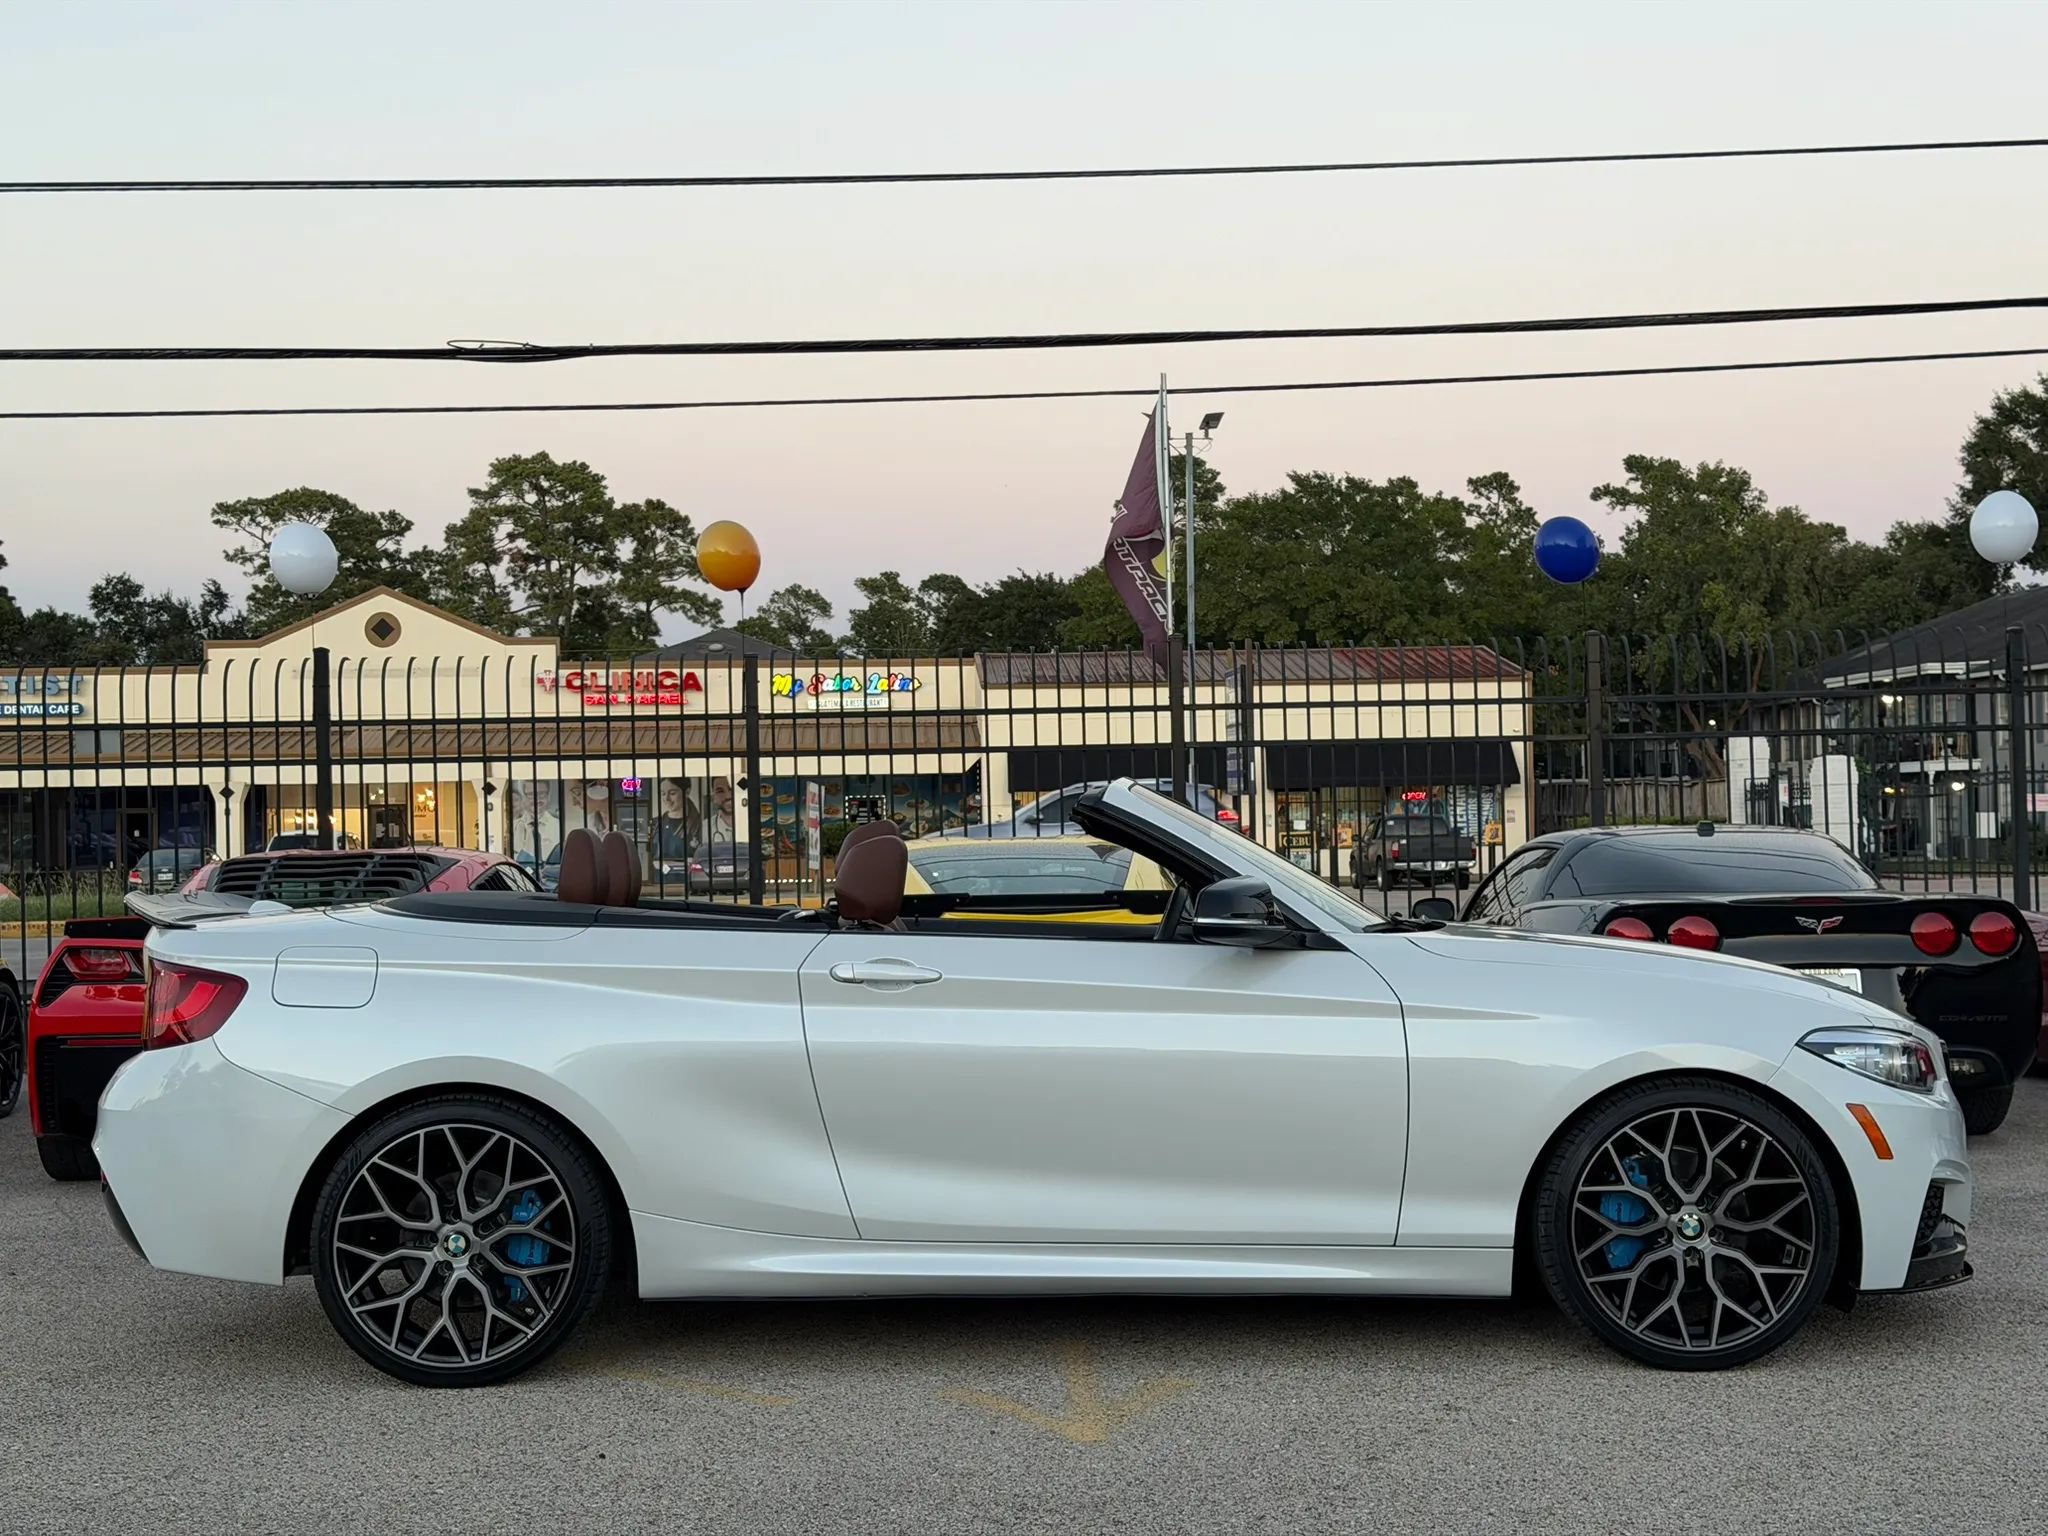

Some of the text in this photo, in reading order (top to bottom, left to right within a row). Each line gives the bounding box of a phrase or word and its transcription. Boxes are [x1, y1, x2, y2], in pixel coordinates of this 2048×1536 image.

[565, 671, 703, 692] CLINICA
[807, 673, 863, 697] Sabor
[866, 672, 922, 695] Latino
[584, 694, 618, 705] SAN
